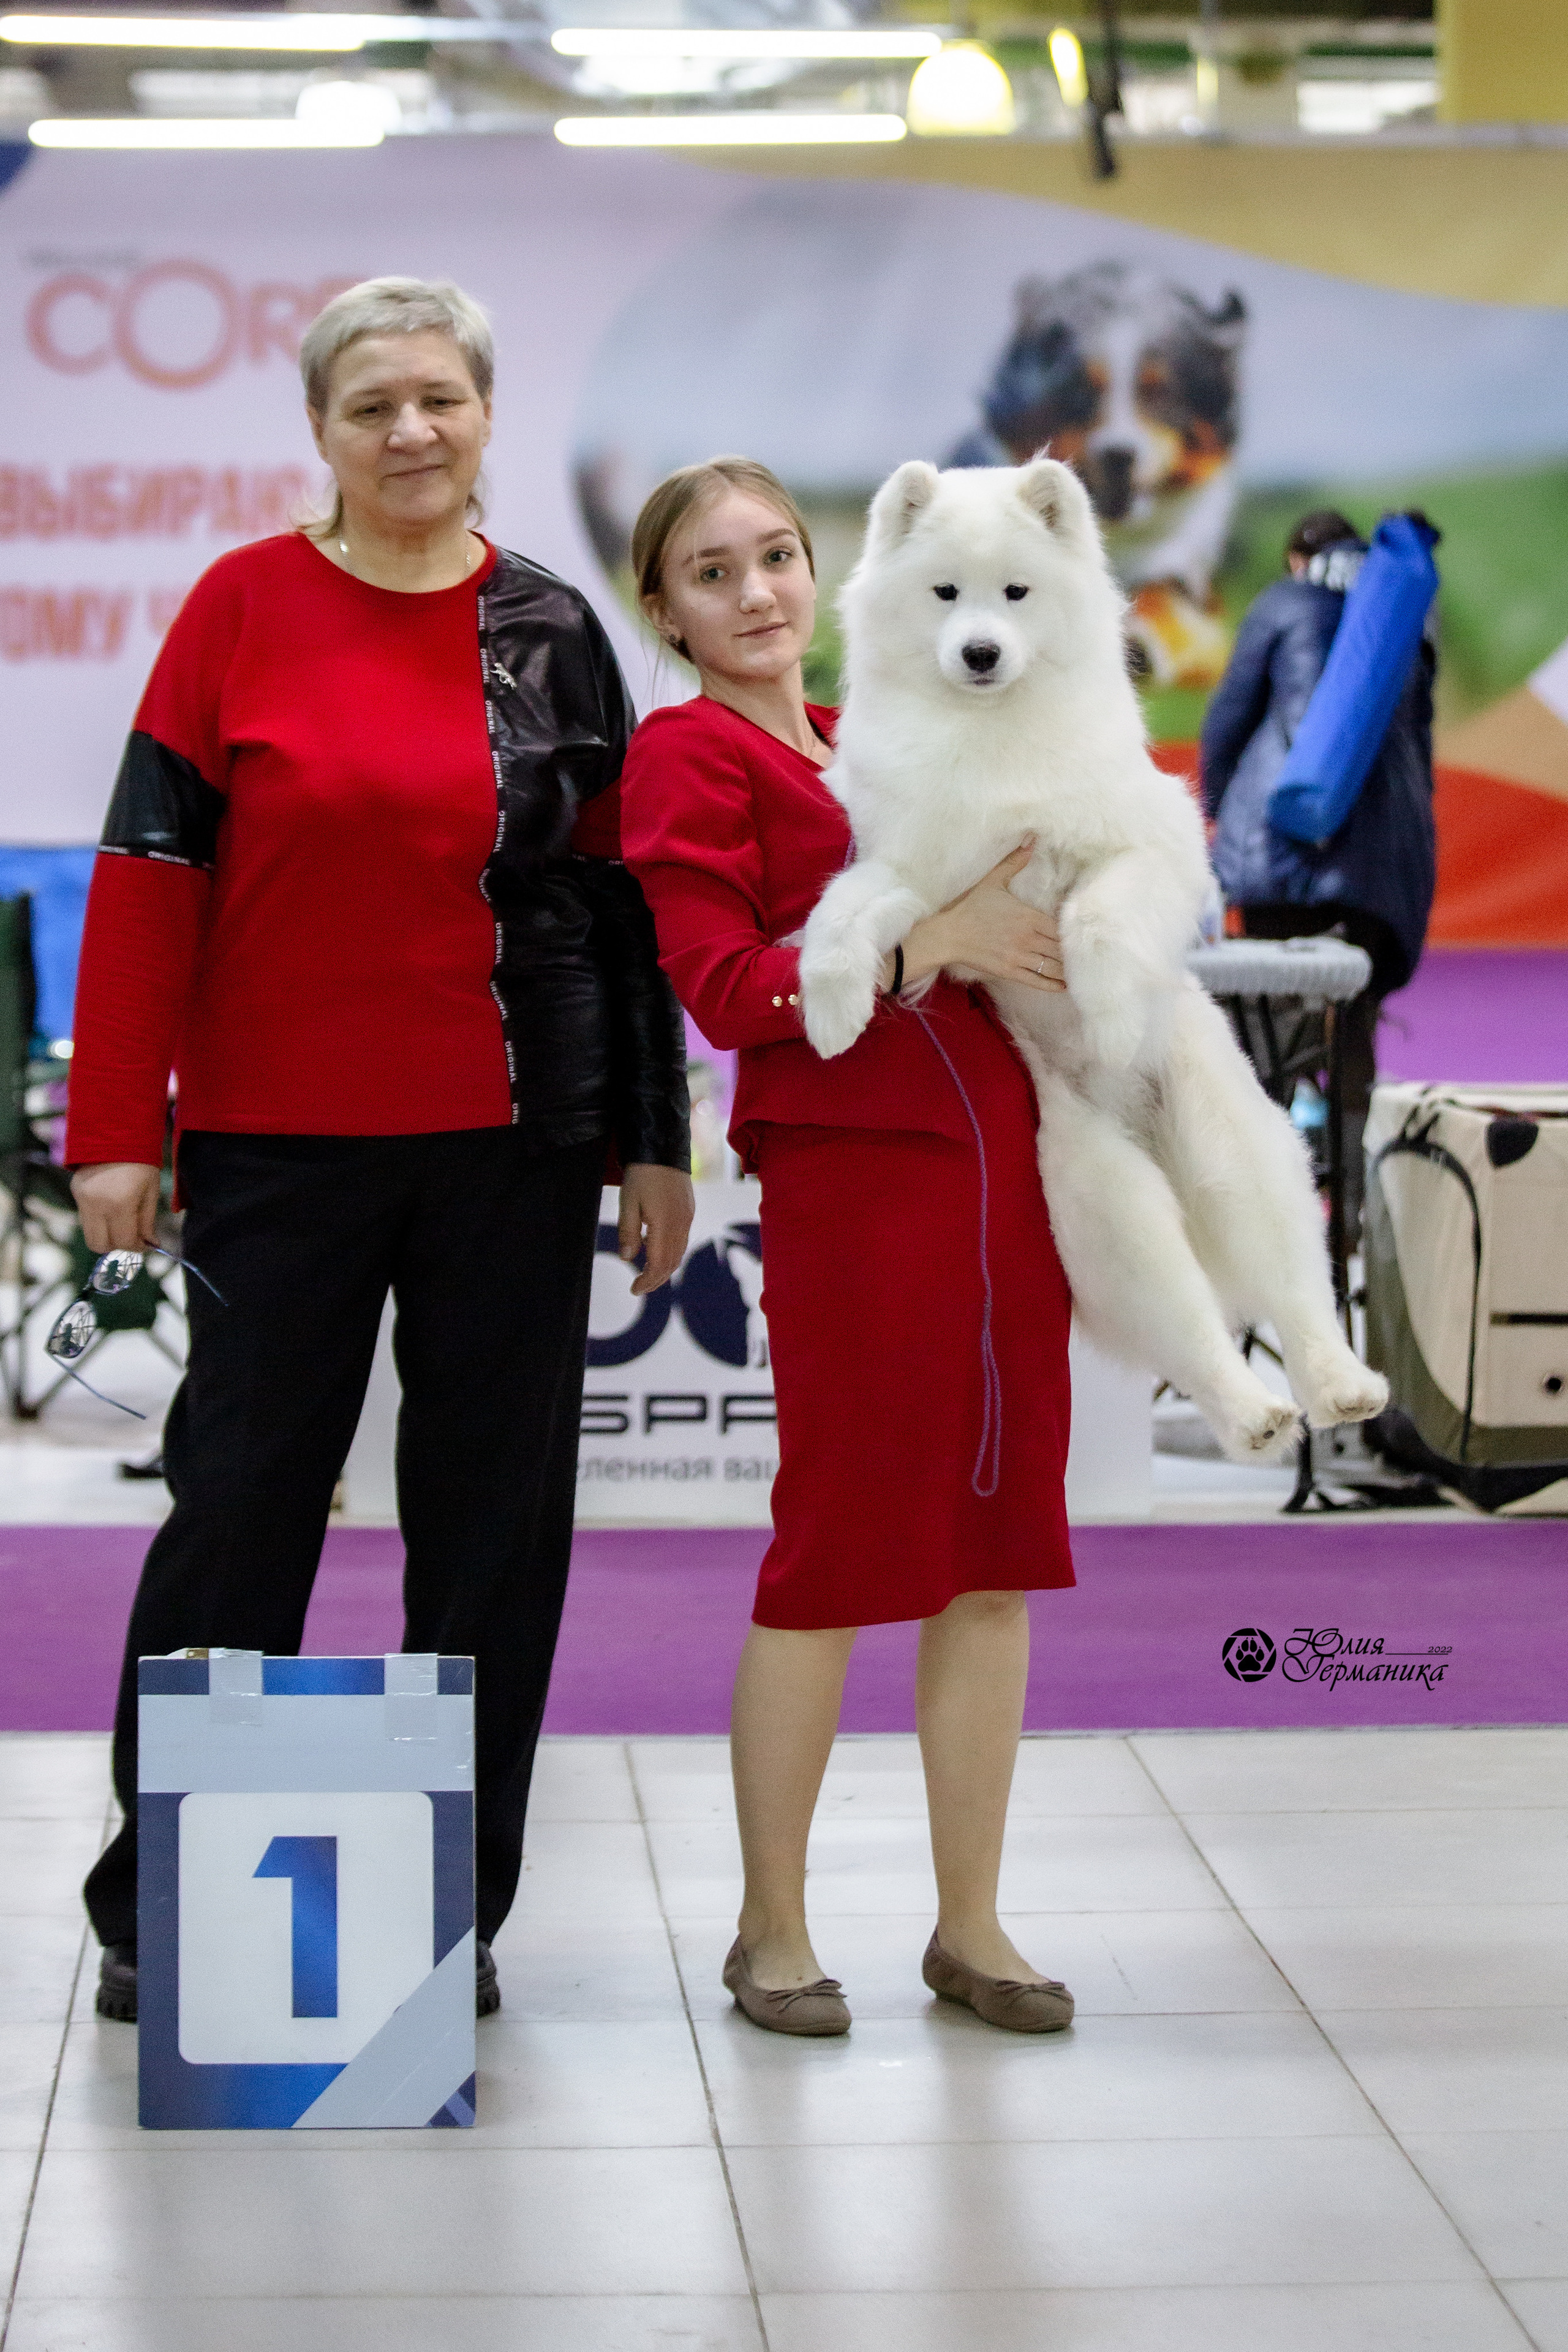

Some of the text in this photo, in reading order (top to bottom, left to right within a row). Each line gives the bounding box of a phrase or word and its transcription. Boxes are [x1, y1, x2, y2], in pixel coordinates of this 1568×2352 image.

[26, 255, 368, 391] COR
[477, 595, 486, 631] ORIGINAL
[480, 648, 491, 684] ORIGINAL
[485, 700, 495, 734] ORIGINAL
[491, 750, 503, 790] ORIGINAL
[492, 810, 505, 853] ORIGINAL
[489, 981, 508, 1021] ORIGINAL
[505, 1041, 516, 1084] ORIGINAL
[581, 1457, 714, 1482] ленная
[252, 1836, 337, 2018] 1
